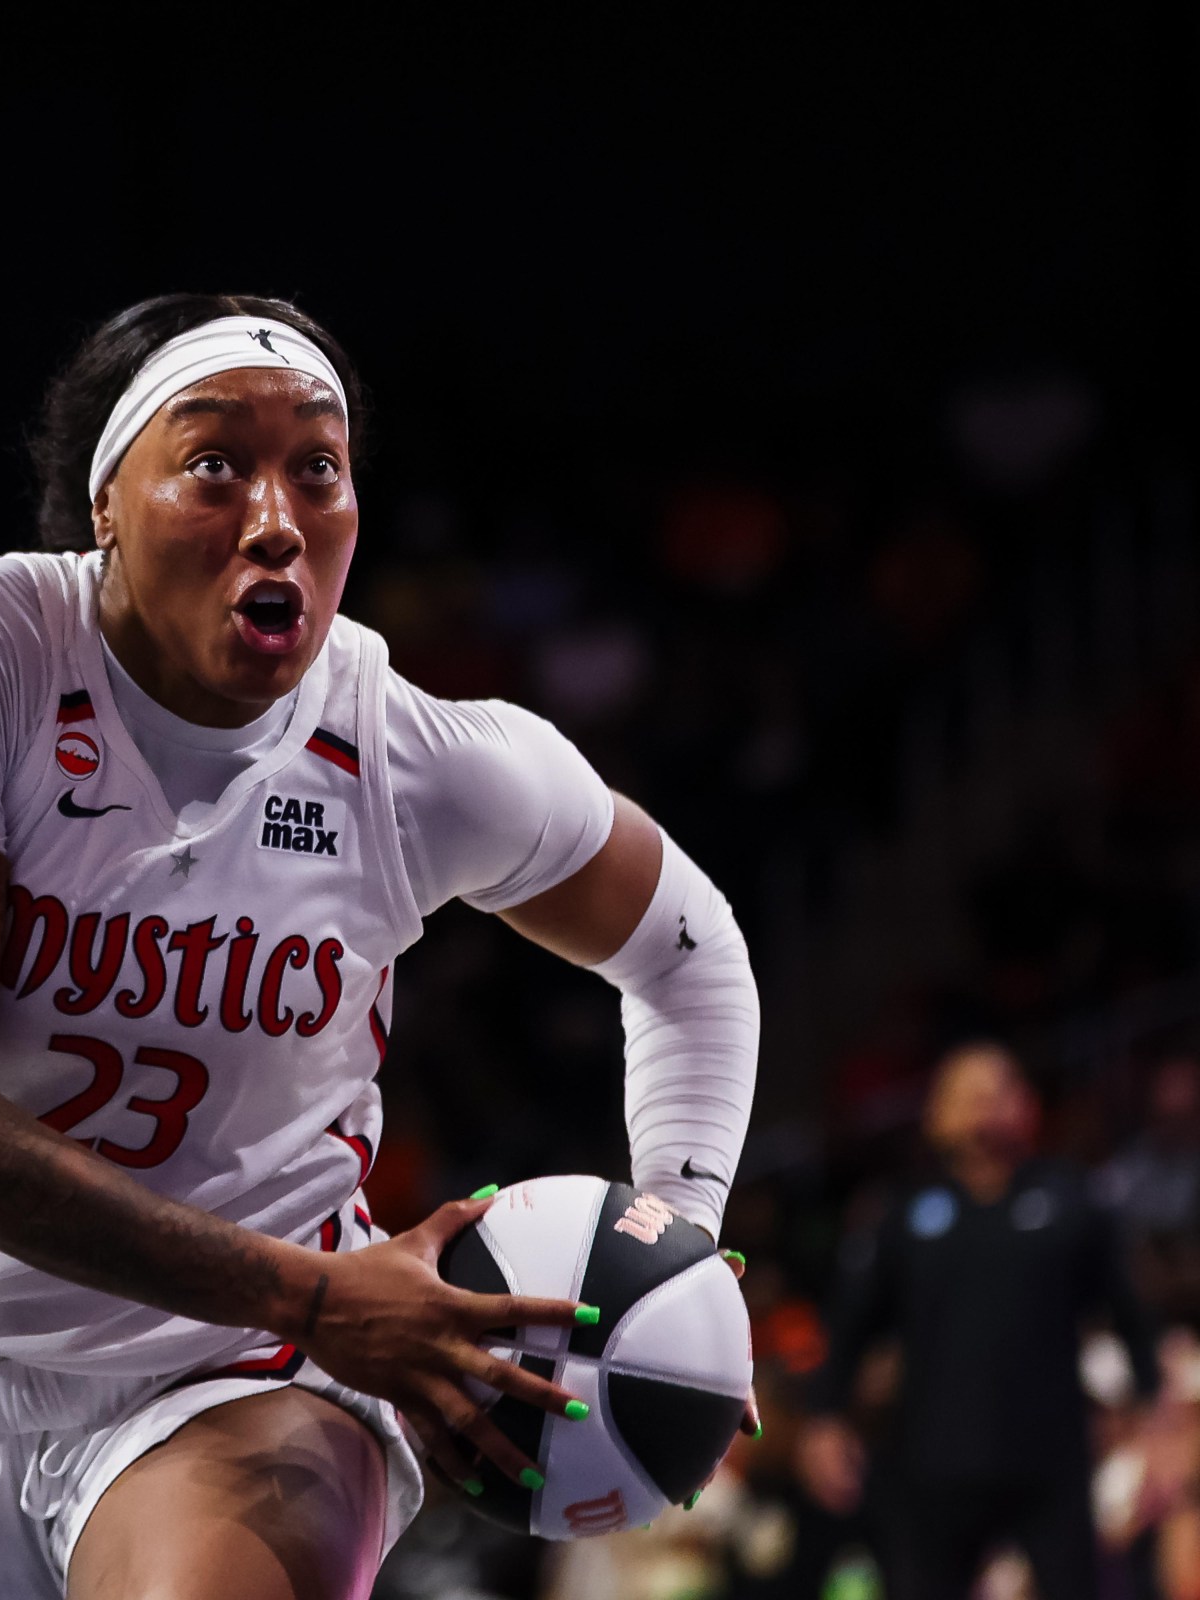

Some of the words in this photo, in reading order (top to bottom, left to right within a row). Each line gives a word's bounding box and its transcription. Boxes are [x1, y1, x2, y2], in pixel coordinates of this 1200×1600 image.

[264, 795, 325, 829] CAR
[261, 821, 339, 857] max
[36, 1033, 209, 1170] 23
